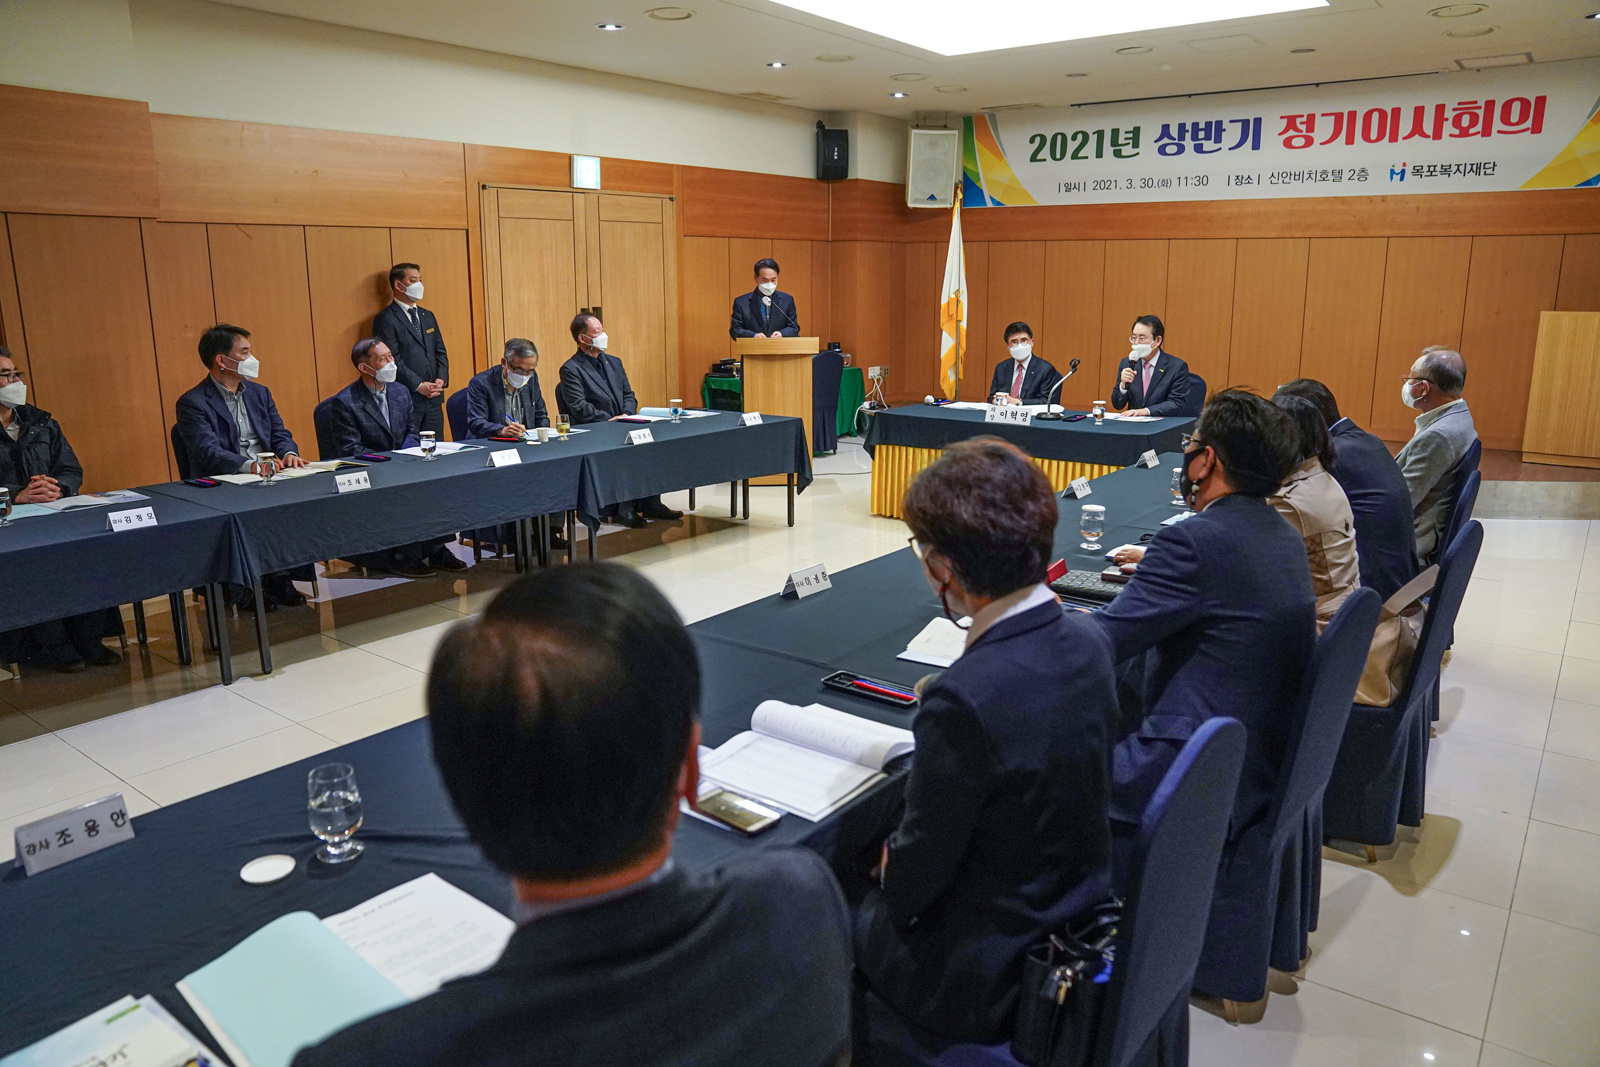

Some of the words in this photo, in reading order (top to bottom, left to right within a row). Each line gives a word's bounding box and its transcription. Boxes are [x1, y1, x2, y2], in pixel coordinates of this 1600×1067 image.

[1028, 126, 1141, 163] 2021년
[1153, 116, 1262, 157] 상반기
[1278, 95, 1547, 150] 정기이사회의
[1176, 175, 1209, 187] 11:30
[1268, 168, 1344, 185] 신안비치호텔
[1347, 167, 1370, 182] 2층
[1411, 161, 1497, 179] 목포복지재단
[25, 838, 51, 856] 감사
